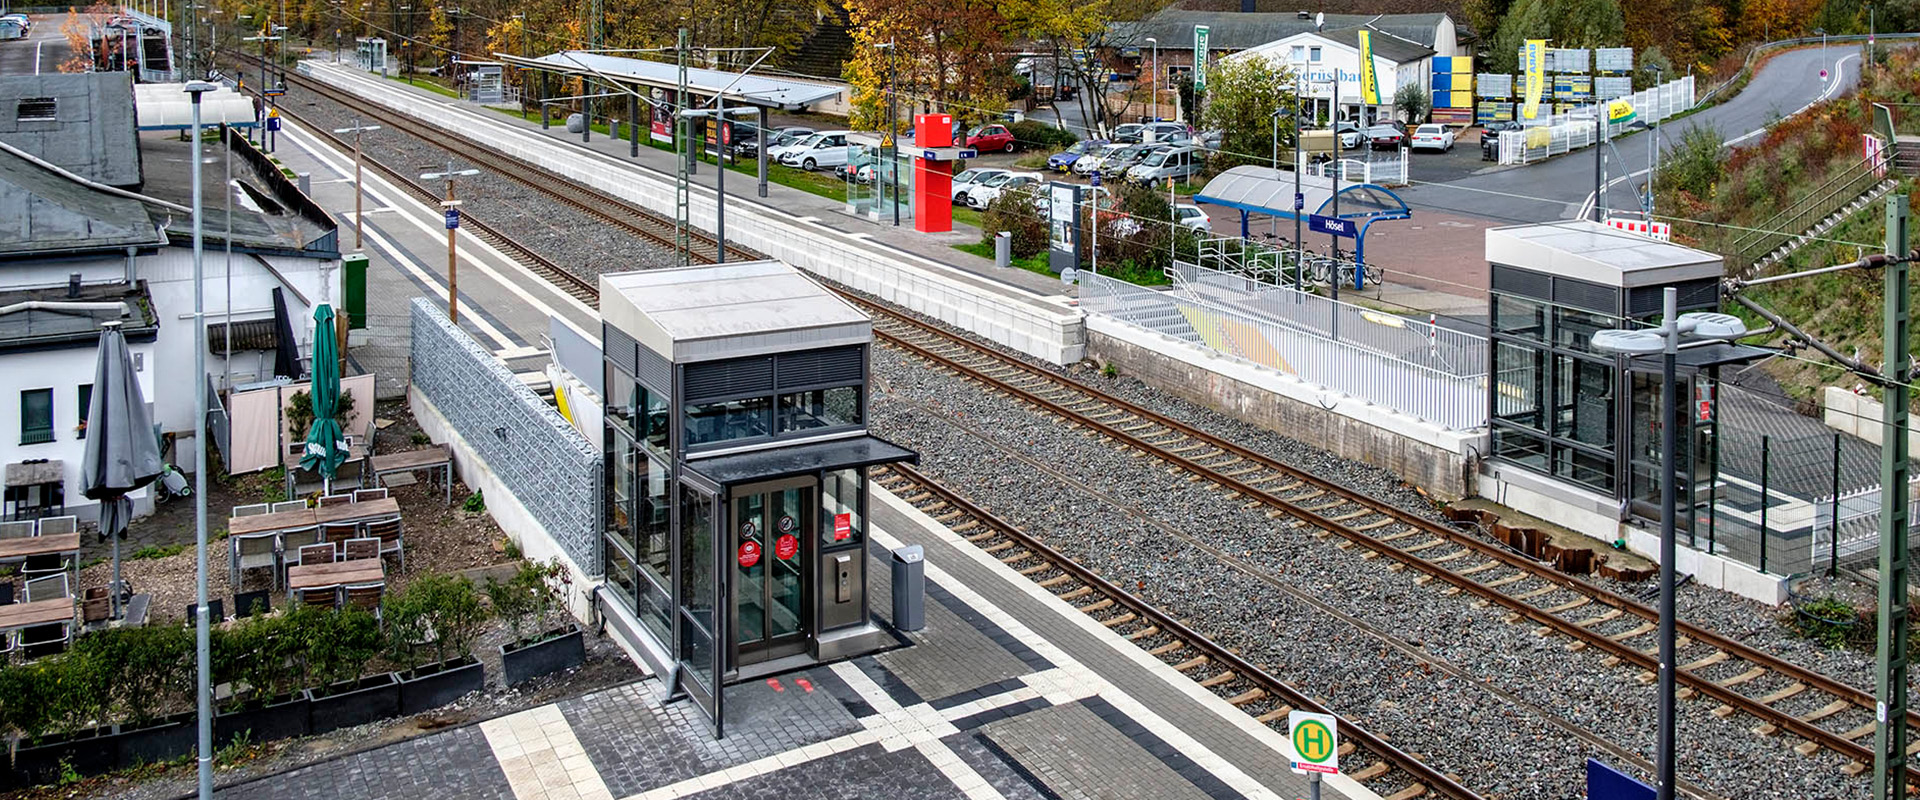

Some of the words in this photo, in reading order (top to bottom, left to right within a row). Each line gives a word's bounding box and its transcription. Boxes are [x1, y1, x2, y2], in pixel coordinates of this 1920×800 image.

[274, 118, 280, 128] 1
[1325, 219, 1344, 232] Hösel
[1303, 727, 1324, 756] H
